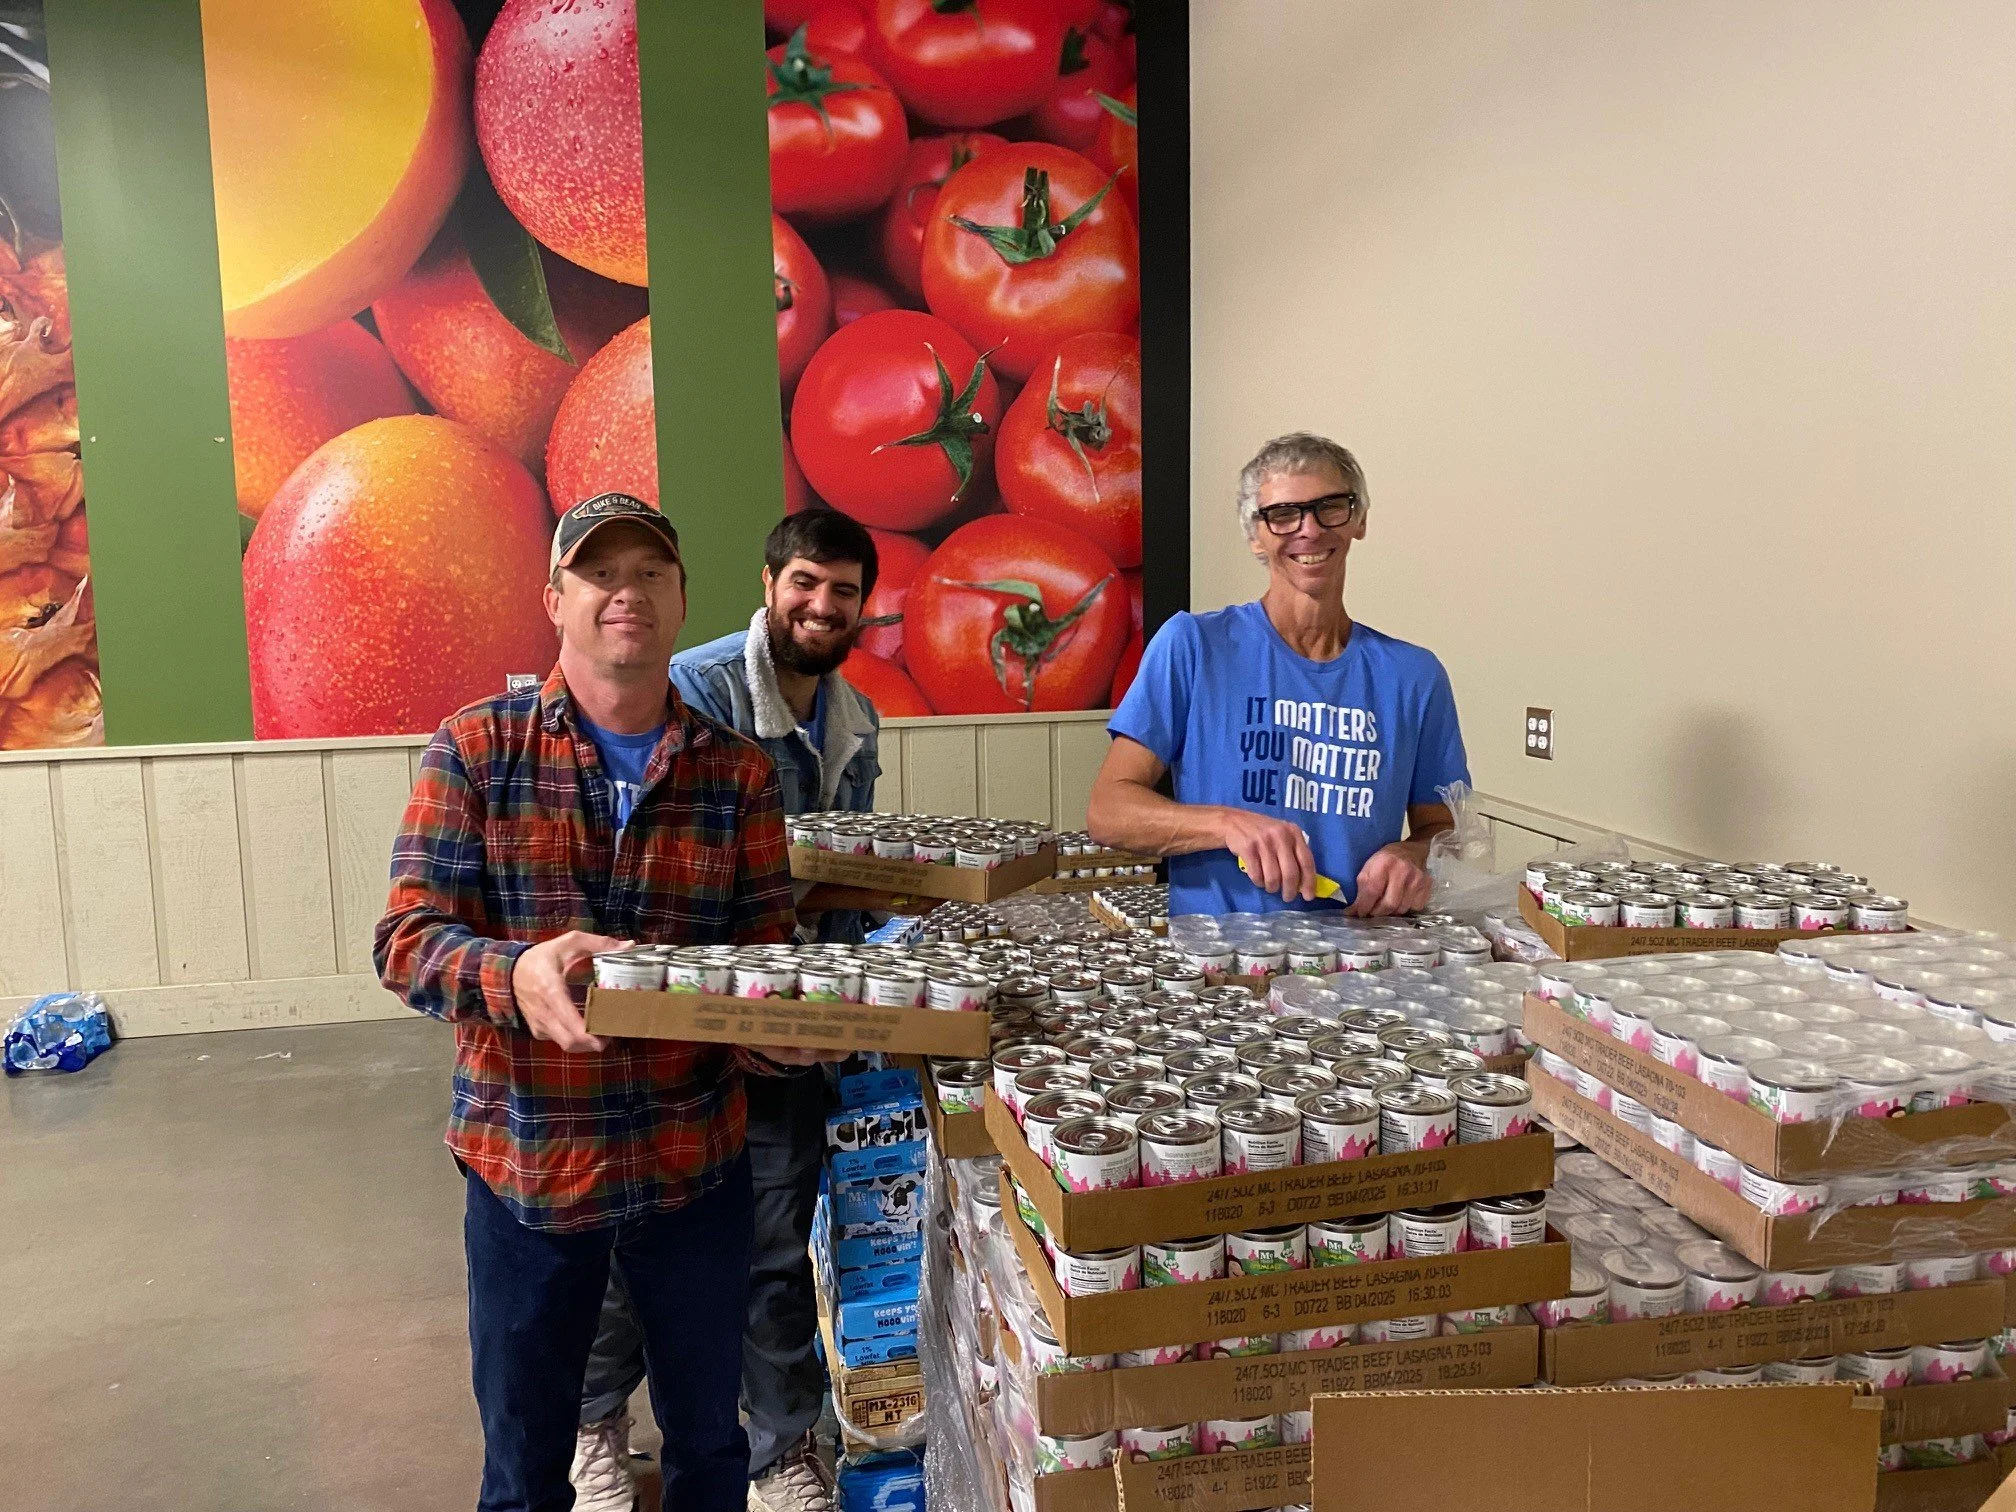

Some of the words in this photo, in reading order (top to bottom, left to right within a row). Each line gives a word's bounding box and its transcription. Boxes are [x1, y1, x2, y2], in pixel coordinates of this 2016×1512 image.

[592, 499, 612, 511] BIKE
[612, 496, 618, 504] &
[1246, 696, 1267, 725] IT
[1274, 699, 1378, 743] MATTERS
[1241, 730, 1285, 762] YOU
[1292, 736, 1381, 782] MATTER
[1242, 769, 1278, 806] WE
[1284, 774, 1374, 818] MATTER
[1681, 937, 1713, 947] TRADER
[1716, 938, 1737, 948] BEEF
[1739, 938, 1778, 948] LASAGNA
[1618, 1052, 1633, 1069] BEEF
[1635, 1061, 1663, 1087] LASAGNA
[1280, 1175, 1325, 1192] TRADER
[1327, 1171, 1354, 1186] BEEF
[1357, 1165, 1411, 1185] LASAGNA
[1203, 1205, 1243, 1222] 118020
[870, 1235, 898, 1247] Keeps
[901, 1231, 918, 1241] you
[850, 1282, 874, 1291] Lowfat
[1261, 1284, 1279, 1299] MC
[1283, 1278, 1329, 1296] TRADER
[1333, 1275, 1361, 1290] BEEF
[1366, 1268, 1421, 1287] LASAGNA
[874, 1307, 902, 1319] Keeps
[905, 1304, 918, 1313] yo
[1207, 1307, 1246, 1327] 118020
[1294, 1297, 1329, 1316] D0722
[1727, 1310, 1773, 1328] TRADER
[855, 1353, 880, 1361] Lowfat
[1288, 1360, 1306, 1375] MC
[1310, 1354, 1359, 1375] TRADER
[1362, 1350, 1392, 1369] BEEF
[1396, 1346, 1454, 1366] LASAGNA
[1456, 1341, 1492, 1359] 70-103
[1233, 1385, 1273, 1402] 118020
[1289, 1381, 1307, 1397] 5-1
[1211, 1457, 1231, 1473] MC
[1234, 1452, 1283, 1472] TRADER
[1285, 1447, 1312, 1464] BEE
[1212, 1481, 1228, 1493] 4-1
